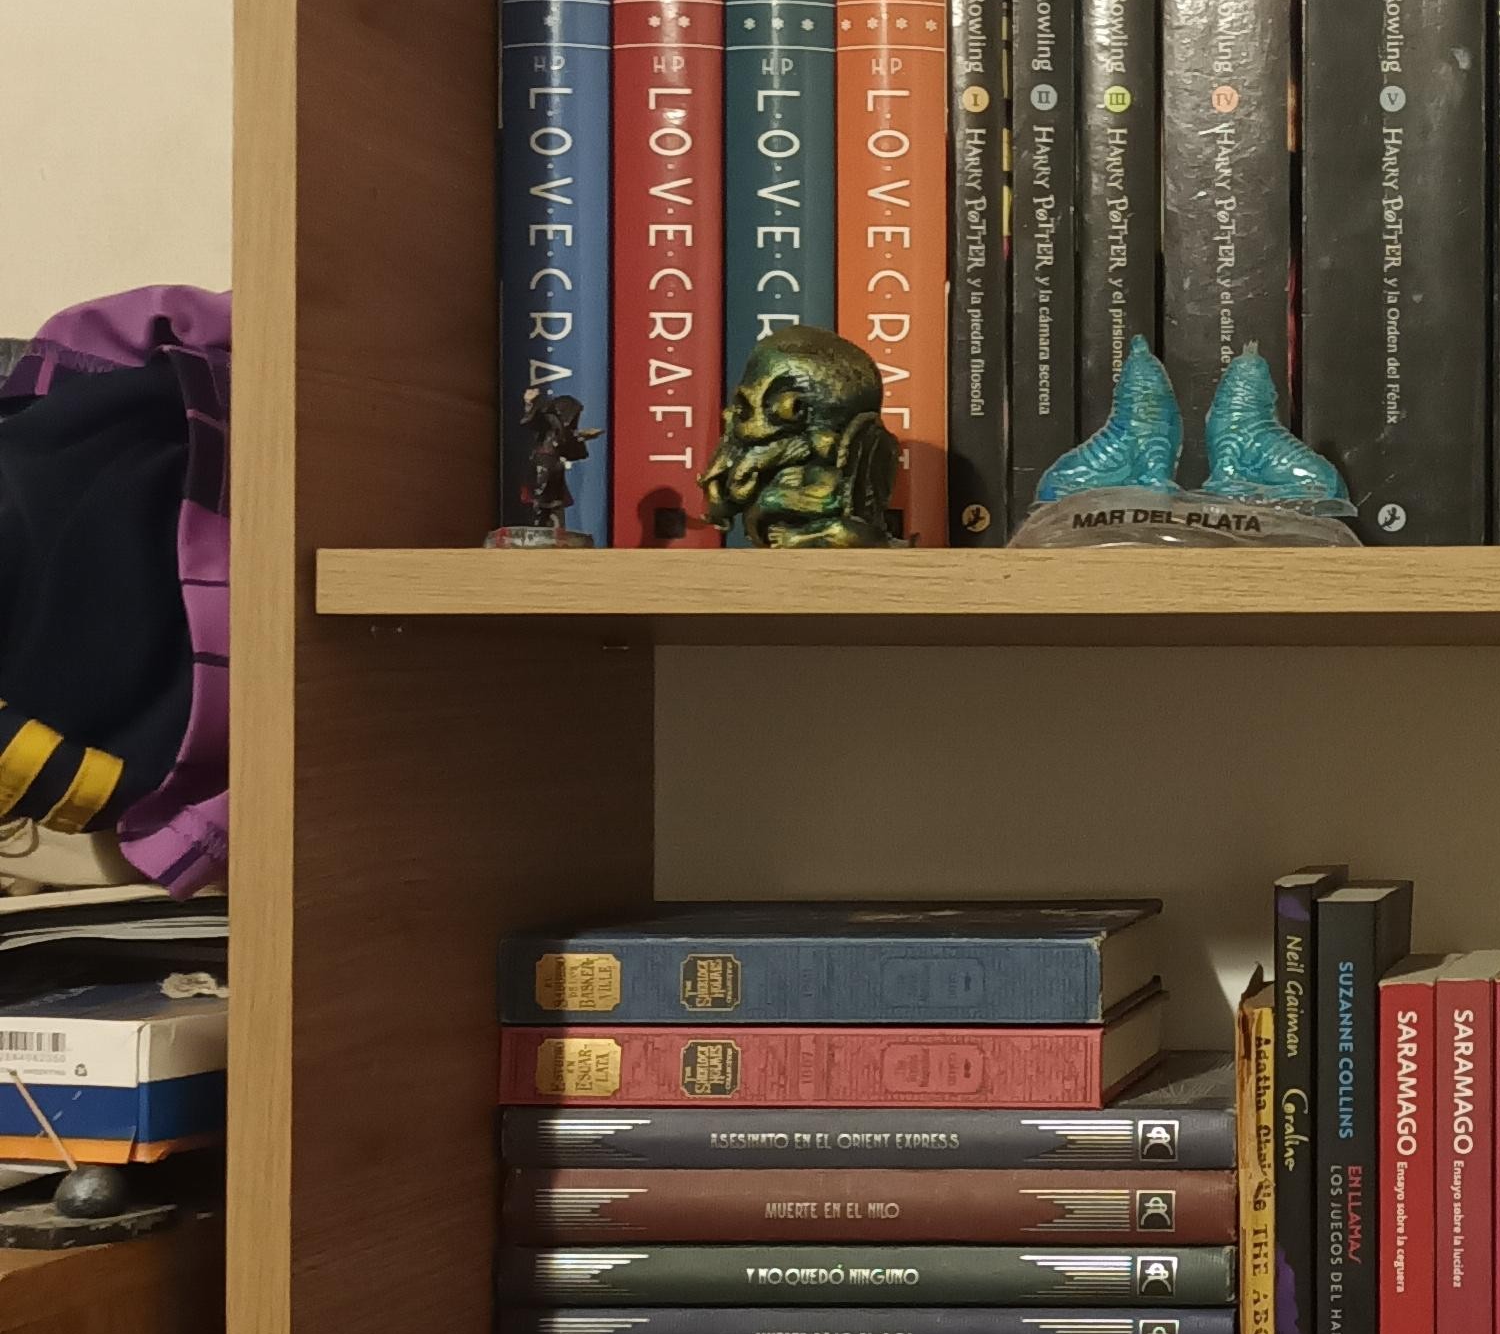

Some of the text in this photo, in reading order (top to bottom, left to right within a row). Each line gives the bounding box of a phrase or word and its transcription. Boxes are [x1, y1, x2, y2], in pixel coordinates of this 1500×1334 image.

[1073, 509, 1261, 533] MAR DEL PLATA
[1281, 935, 1309, 1171] Neil Gaiman Coraline
[1337, 961, 1355, 1138] SUZANNE COLLINS
[1397, 1010, 1418, 1156] SARAMAGO
[1453, 1009, 1474, 1155] SARAMAGO
[710, 1132, 960, 1150] ASESINATO EN EL ORIENT EXPRESS
[1330, 1165, 1344, 1195] LOS
[1395, 1161, 1408, 1200] Ensayo
[1451, 1160, 1464, 1199] Ensayo
[764, 1201, 901, 1220] MUERTE EN EL NILO
[1395, 1203, 1407, 1233] sobre
[1452, 1202, 1464, 1233] sobre
[1329, 1202, 1343, 1264] JUEGOS
[1329, 1271, 1343, 1302] DEL
[1393, 1248, 1406, 1292] ceguera
[1452, 1247, 1464, 1288] lucidez
